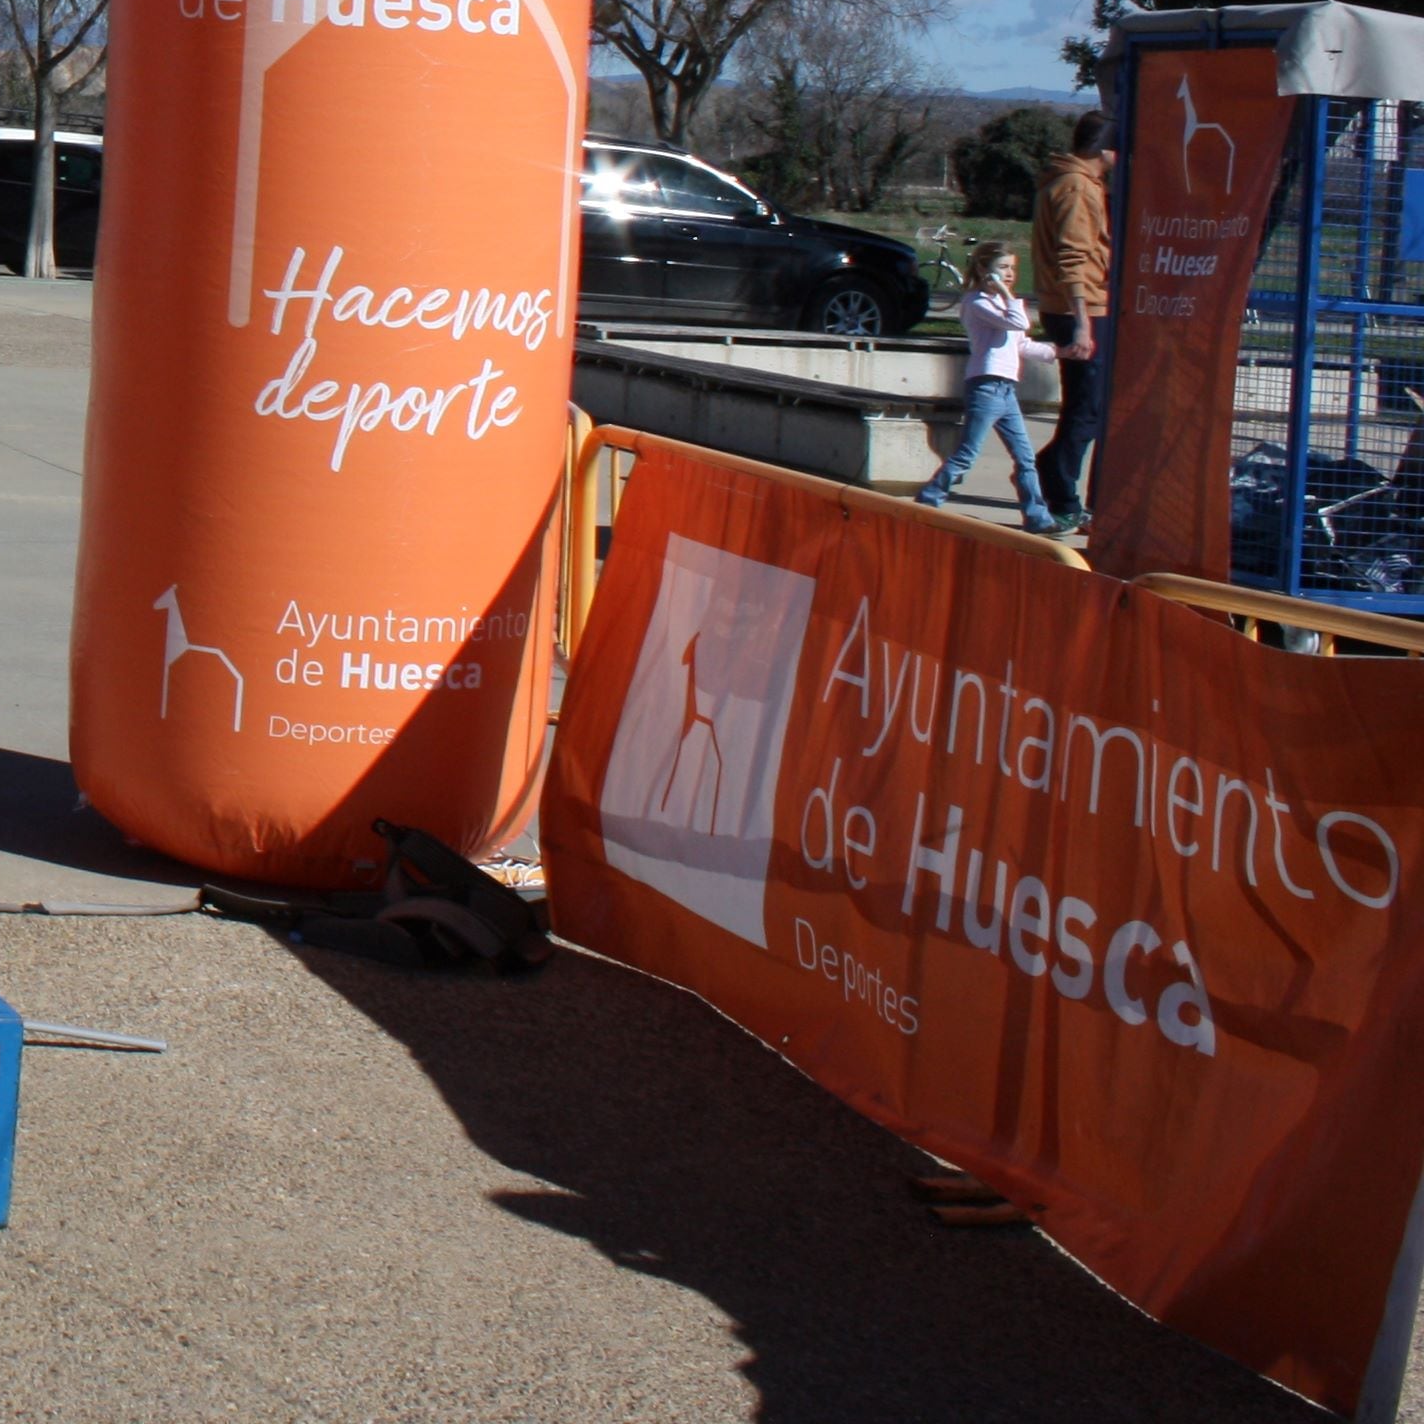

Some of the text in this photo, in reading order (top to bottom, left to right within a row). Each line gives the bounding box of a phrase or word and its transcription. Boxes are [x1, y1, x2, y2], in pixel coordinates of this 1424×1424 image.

[262, 244, 554, 352] Hacemos
[1155, 245, 1219, 277] Huesca
[254, 336, 524, 473] deporte
[275, 599, 527, 649] Ayuntamiento
[275, 649, 483, 691] de Huesca
[268, 714, 397, 746] Deportes
[822, 594, 1401, 910] Ayuntamiento
[800, 757, 1216, 1059] de Huesca
[794, 916, 921, 1037] Deportes
